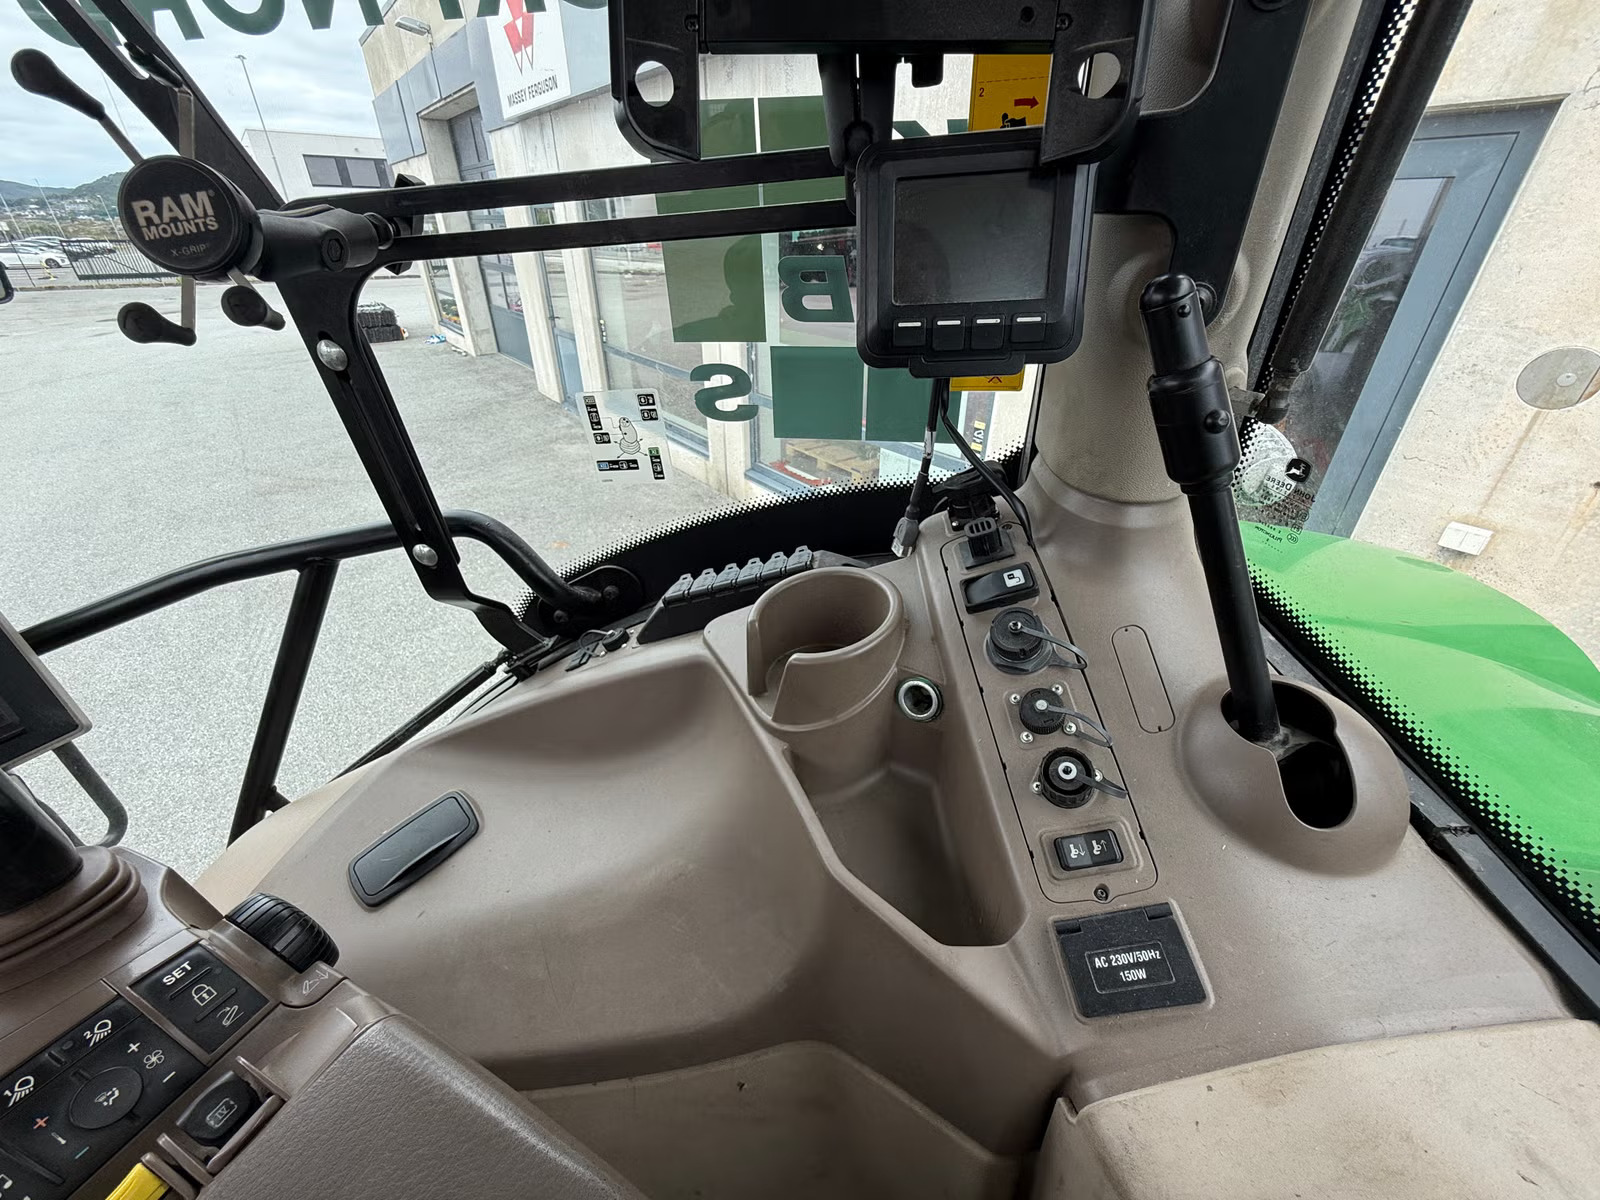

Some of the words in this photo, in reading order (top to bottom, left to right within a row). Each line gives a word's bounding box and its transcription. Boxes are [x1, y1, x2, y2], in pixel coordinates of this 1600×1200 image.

[507, 88, 527, 107] MASSEY
[528, 74, 558, 100] FERGUSON
[978, 87, 985, 97] 2
[131, 190, 215, 226] RAM
[141, 216, 219, 241] MOUNTS
[1094, 955, 1109, 969] AC
[1109, 949, 1162, 966] 230V/50Hz
[162, 960, 192, 986] SET
[1119, 967, 1147, 982] 150W
